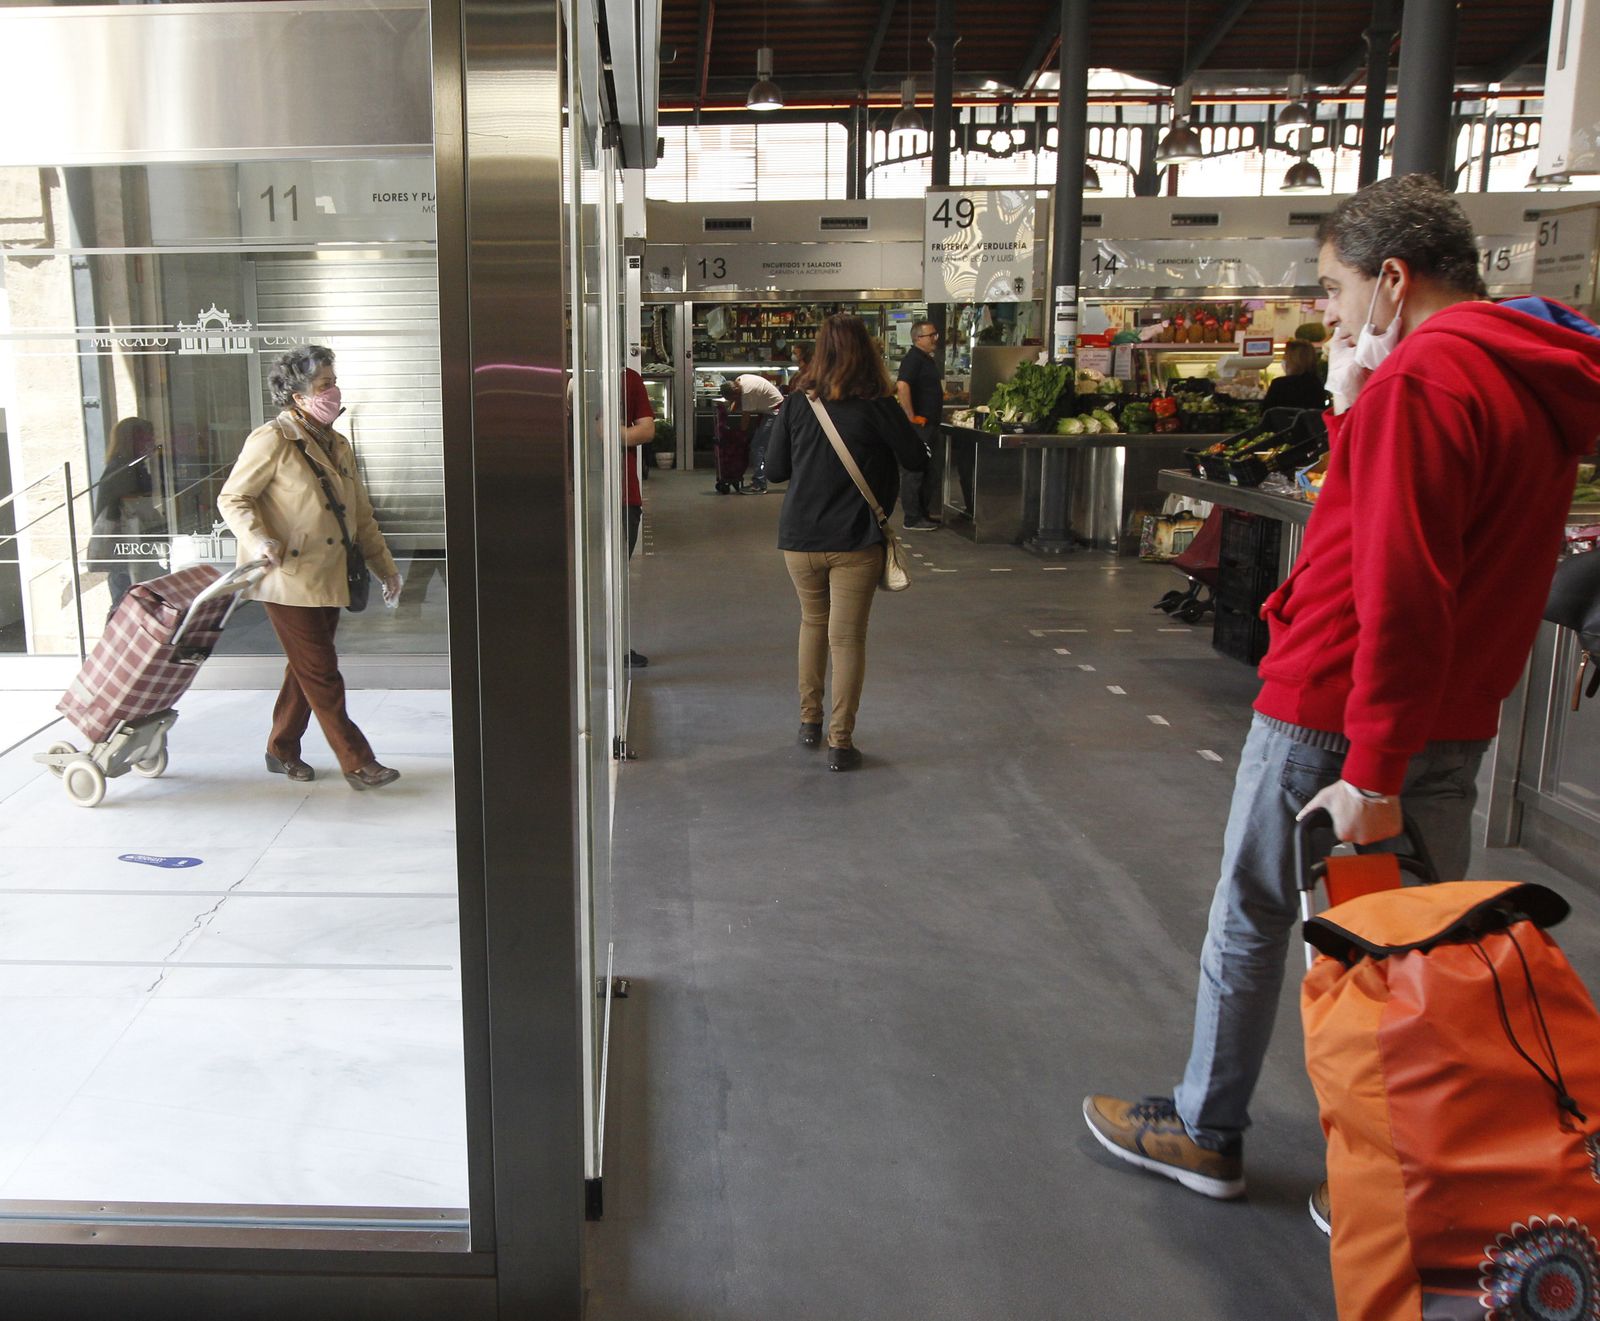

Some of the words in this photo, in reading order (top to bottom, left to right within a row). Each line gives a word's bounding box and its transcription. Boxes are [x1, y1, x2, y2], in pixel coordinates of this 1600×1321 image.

[260, 184, 298, 222] 11
[372, 193, 409, 202] FLORES
[412, 192, 418, 201] Y
[932, 198, 975, 229] 49
[1538, 220, 1558, 246] 51
[931, 243, 969, 251] FRUTERÍA
[976, 241, 1027, 250] VERDULERÍA
[698, 257, 727, 279] 13
[1091, 254, 1119, 275] 14
[1156, 257, 1194, 265] CARNICERÍA
[1483, 249, 1511, 271] 15
[113, 542, 172, 555] MERCAD
